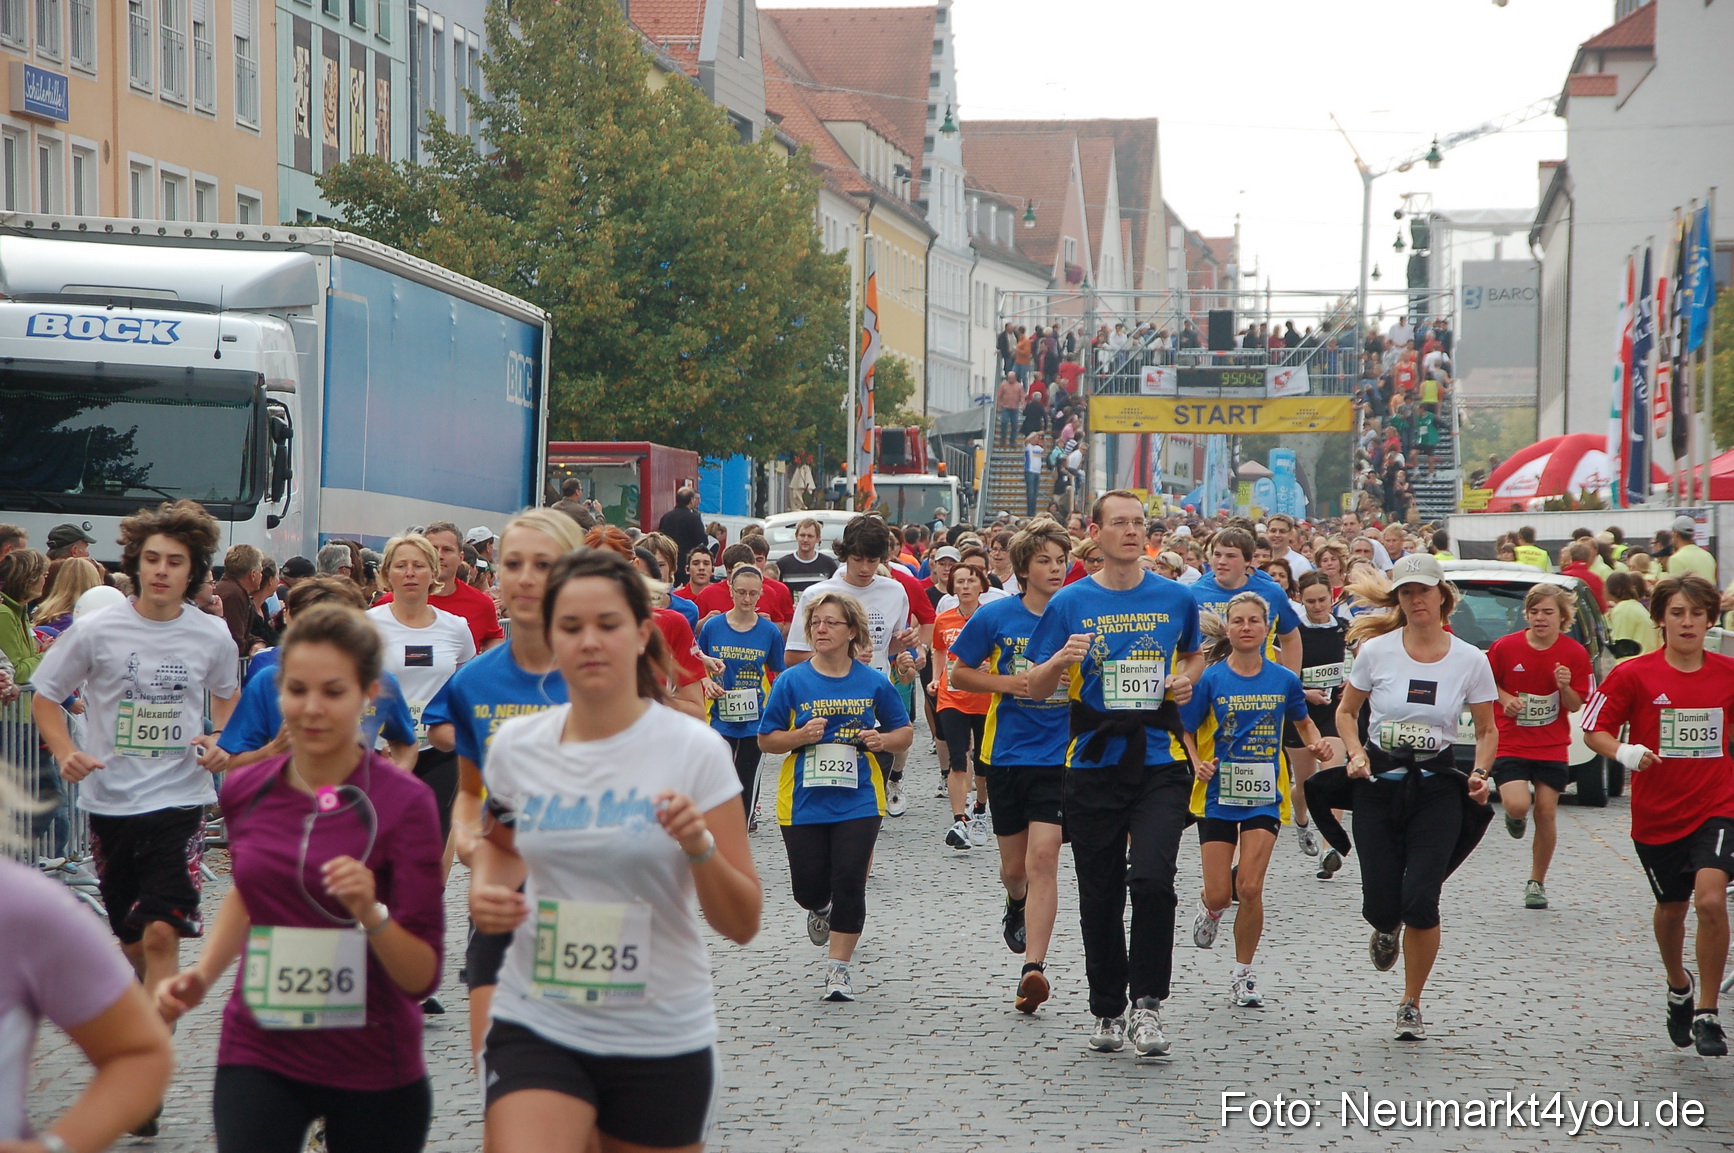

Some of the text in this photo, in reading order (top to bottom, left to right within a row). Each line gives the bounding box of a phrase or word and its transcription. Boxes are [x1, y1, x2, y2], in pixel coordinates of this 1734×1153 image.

[26, 312, 182, 346] BOCK
[507, 350, 533, 408] BOC
[1174, 404, 1263, 426] START
[1152, 501, 1160, 511] A
[1082, 613, 1170, 629] 10. NEUMARKTER
[1096, 622, 1157, 635] STADTLAUF
[720, 652, 758, 661] STADTLAUF
[721, 646, 766, 657] NEUMARKTER
[1120, 664, 1158, 674] Bernhard
[1315, 667, 1340, 678] 5008
[1122, 679, 1160, 693] 5017
[474, 704, 493, 719] 10.
[729, 700, 755, 712] 5110
[800, 702, 812, 712] 10.
[811, 706, 865, 717] STADTLAUF
[1228, 702, 1277, 711] STADTLAUF
[1530, 703, 1557, 717] 5034
[137, 707, 183, 719] Alexander
[1678, 712, 1710, 722] Dominik
[137, 725, 183, 741] 5010
[1400, 723, 1431, 734] Petra
[1679, 727, 1718, 742] 5035
[1397, 734, 1437, 750] 5230
[820, 759, 854, 774] 5232
[1234, 766, 1255, 776] Doris
[1235, 780, 1271, 793] 5053
[564, 943, 639, 972] 5235
[277, 967, 355, 994] 5236
